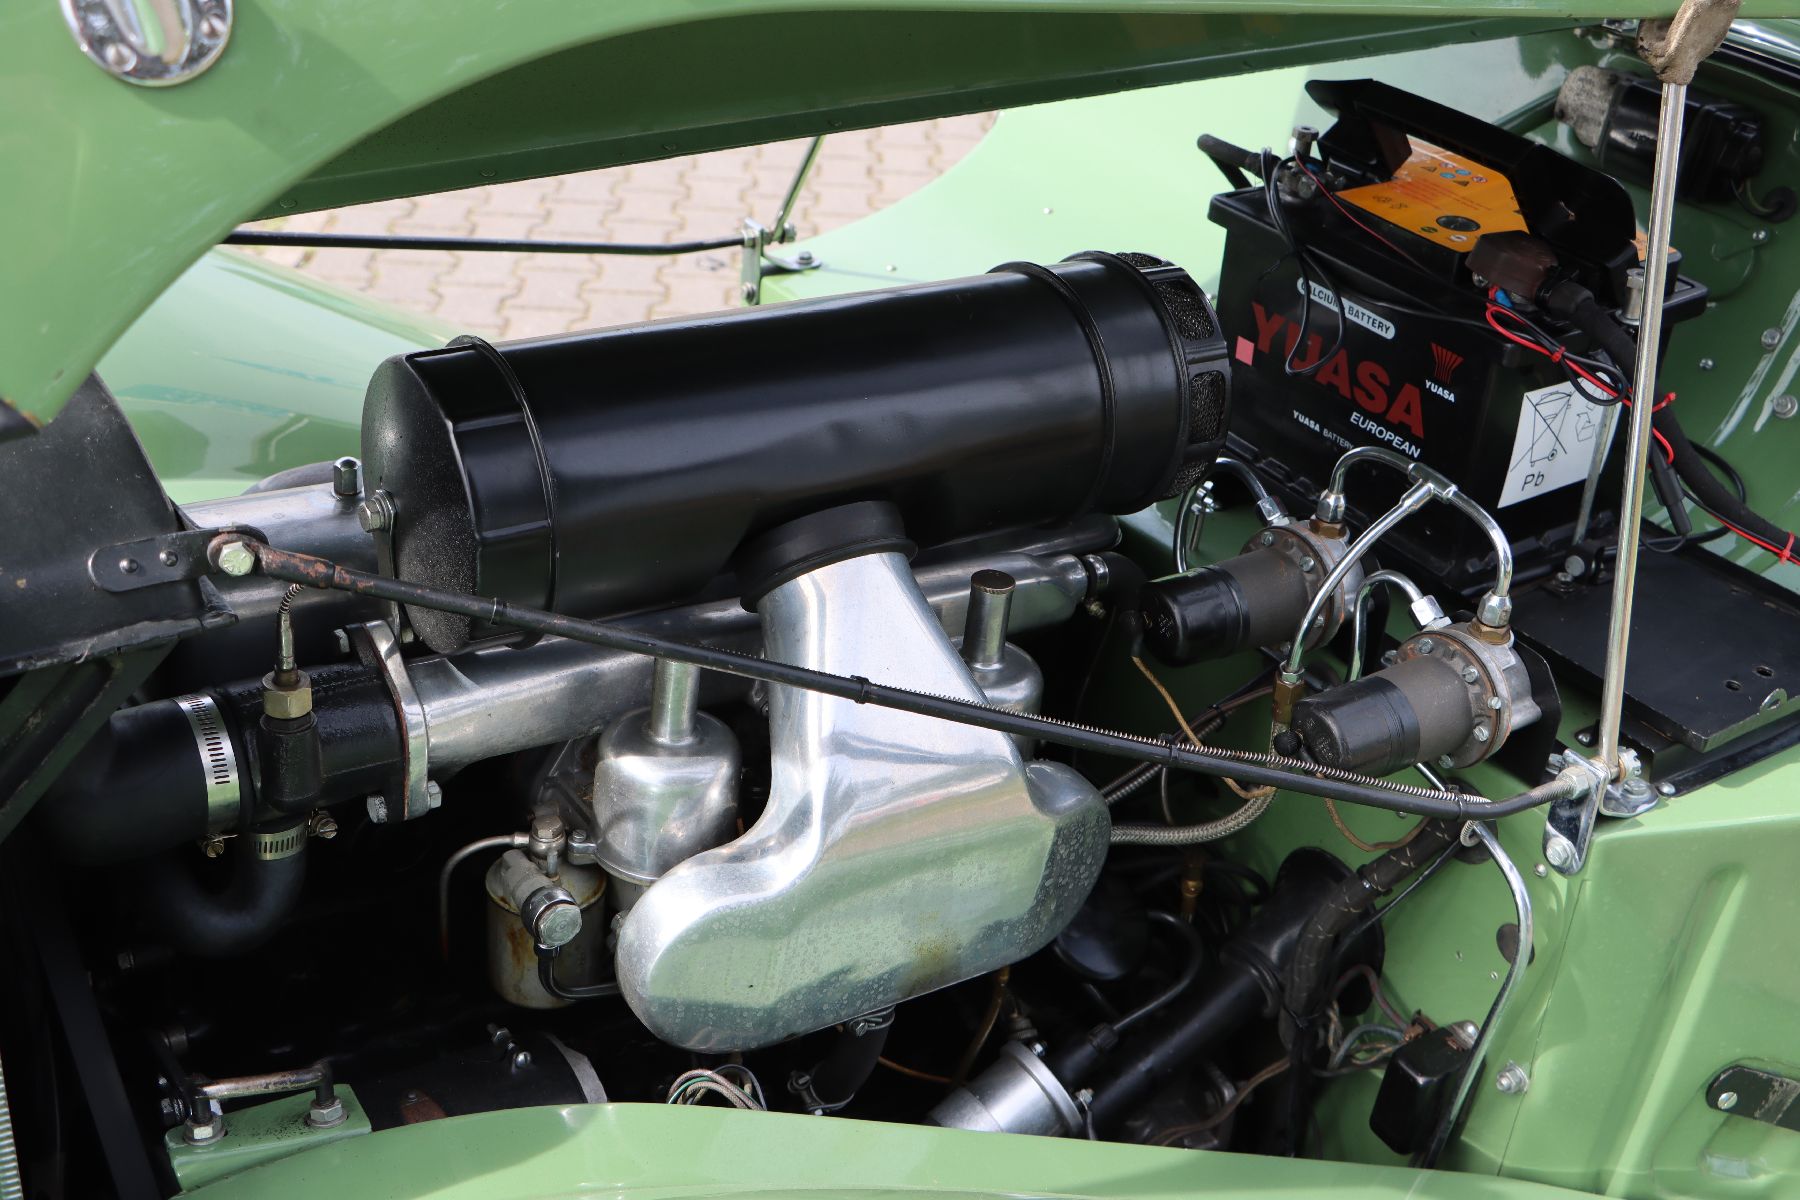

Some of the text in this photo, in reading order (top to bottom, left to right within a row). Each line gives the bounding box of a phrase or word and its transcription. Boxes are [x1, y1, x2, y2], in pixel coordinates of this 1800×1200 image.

[1348, 305, 1391, 335] BATTERY
[1252, 301, 1425, 439] YUASA
[1425, 379, 1455, 403] YUASA
[1293, 409, 1354, 450] YUASA BATTERY
[1350, 411, 1421, 459] EUROPEAN
[1521, 471, 1545, 491] Pb
